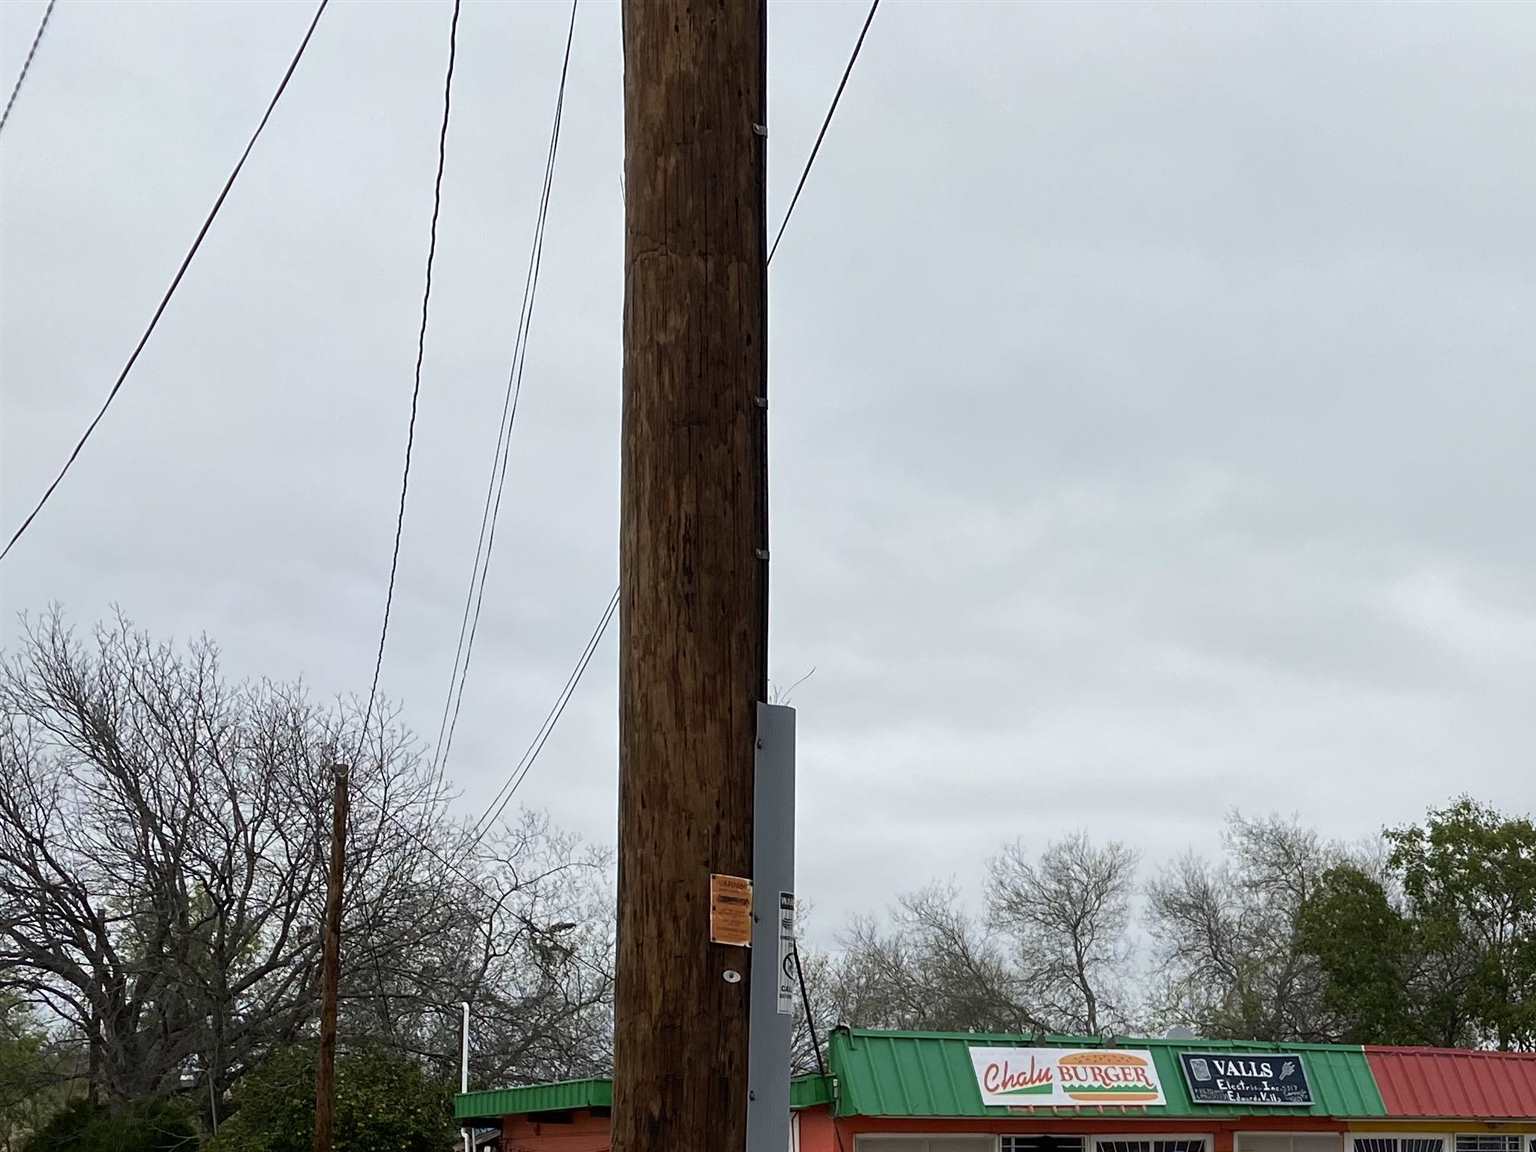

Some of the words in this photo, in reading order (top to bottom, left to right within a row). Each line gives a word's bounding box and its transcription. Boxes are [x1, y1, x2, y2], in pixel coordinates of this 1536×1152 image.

[984, 1056, 1053, 1092] Chalu
[1057, 1065, 1153, 1088] BURGER
[1213, 1060, 1273, 1078] VALLS
